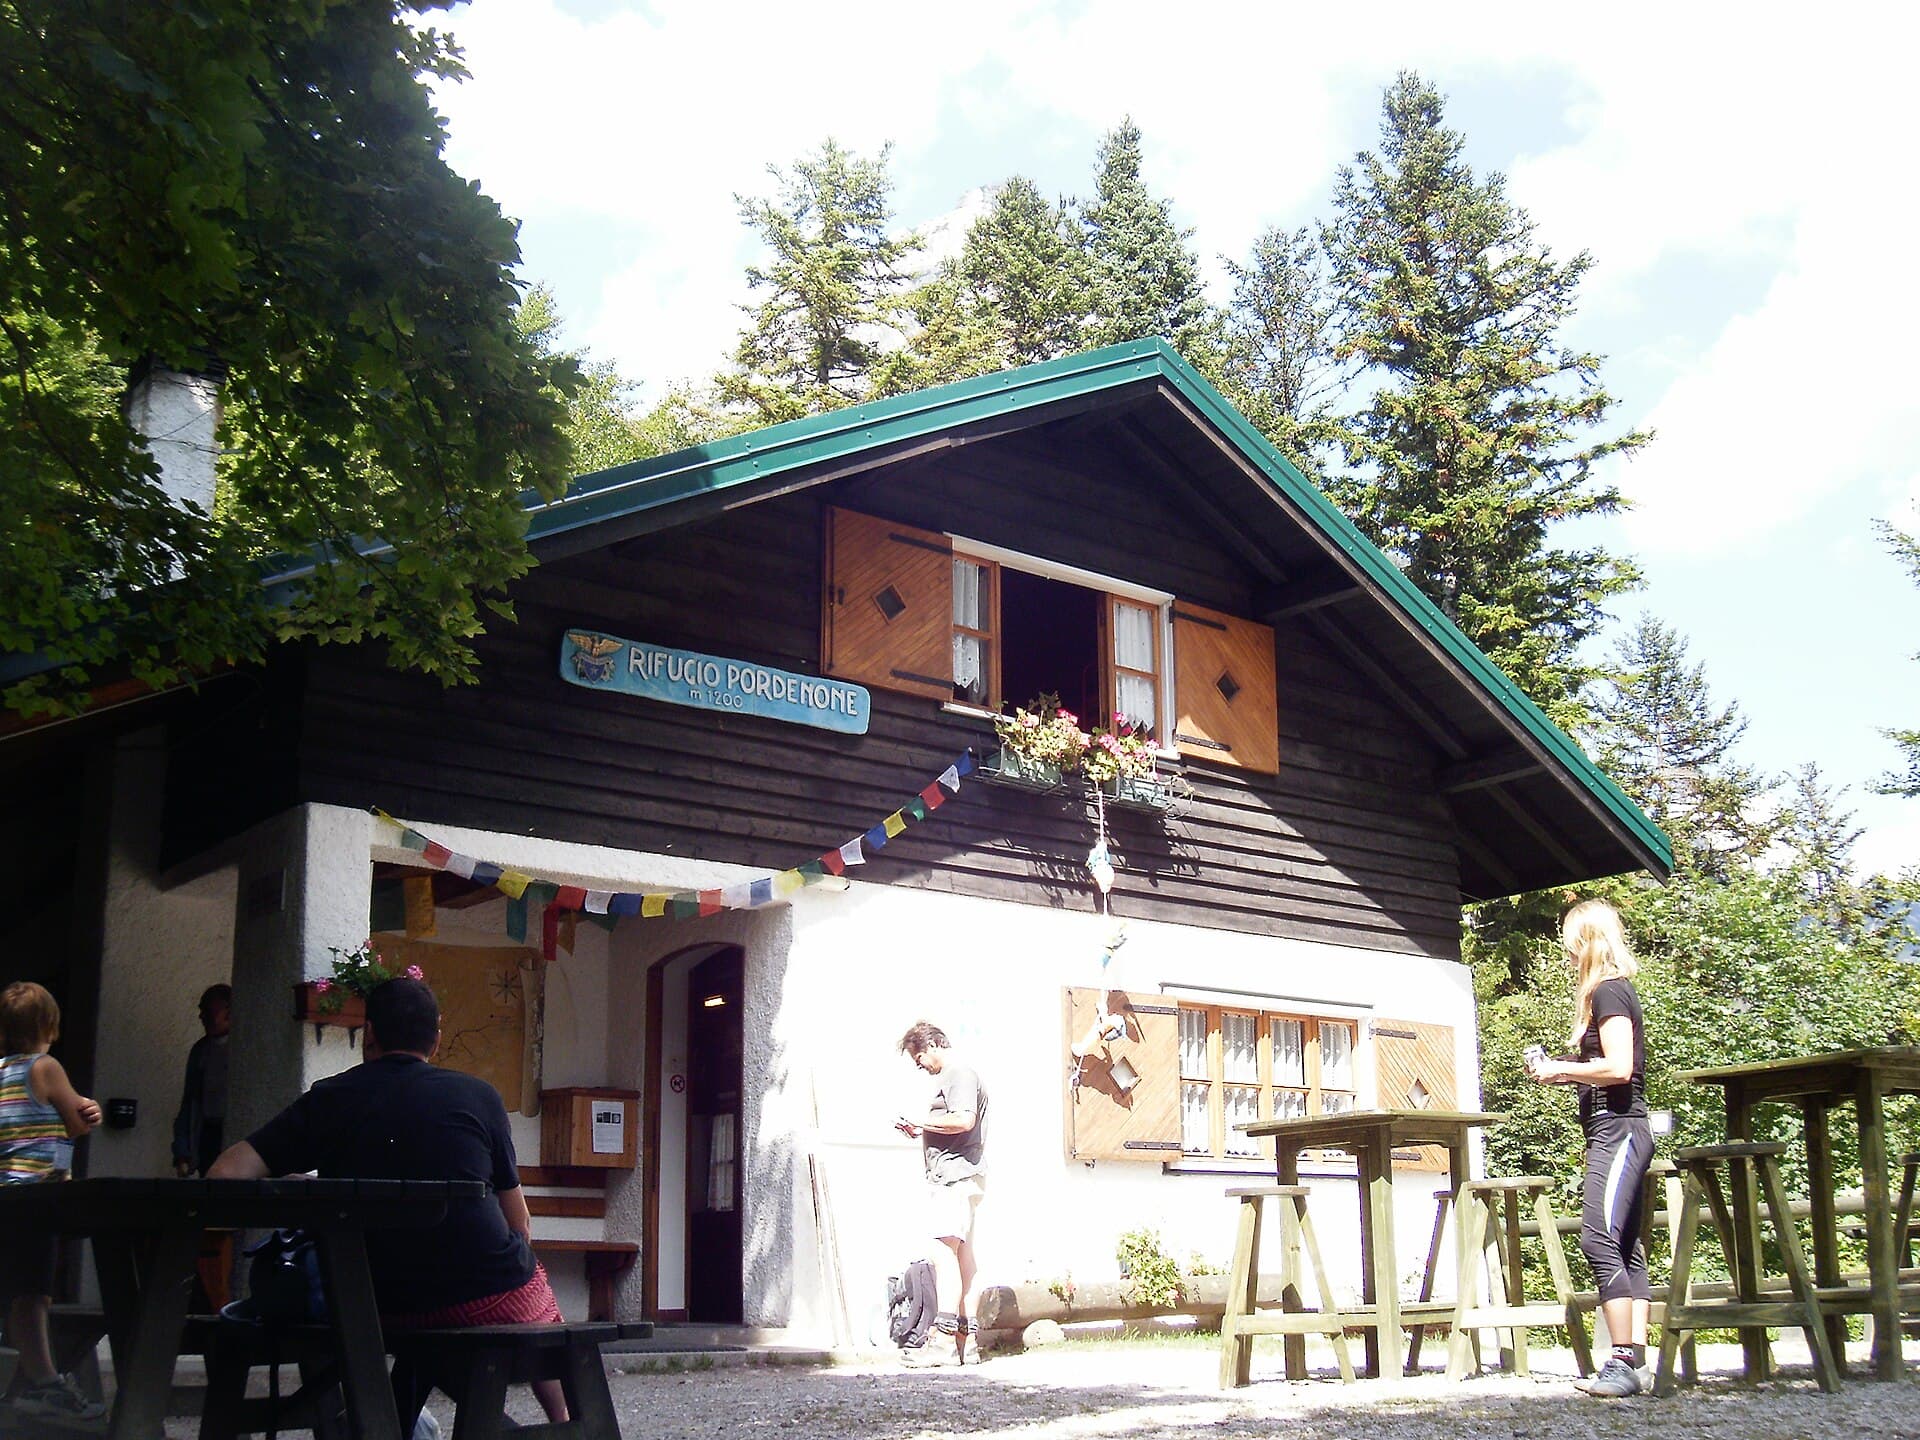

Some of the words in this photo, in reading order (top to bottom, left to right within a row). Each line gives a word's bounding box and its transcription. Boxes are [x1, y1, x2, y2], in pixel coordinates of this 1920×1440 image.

[629, 647, 720, 688] RIFUGIO
[727, 664, 858, 716] PORDENONE
[690, 689, 702, 700] m
[707, 690, 743, 709] 1200
